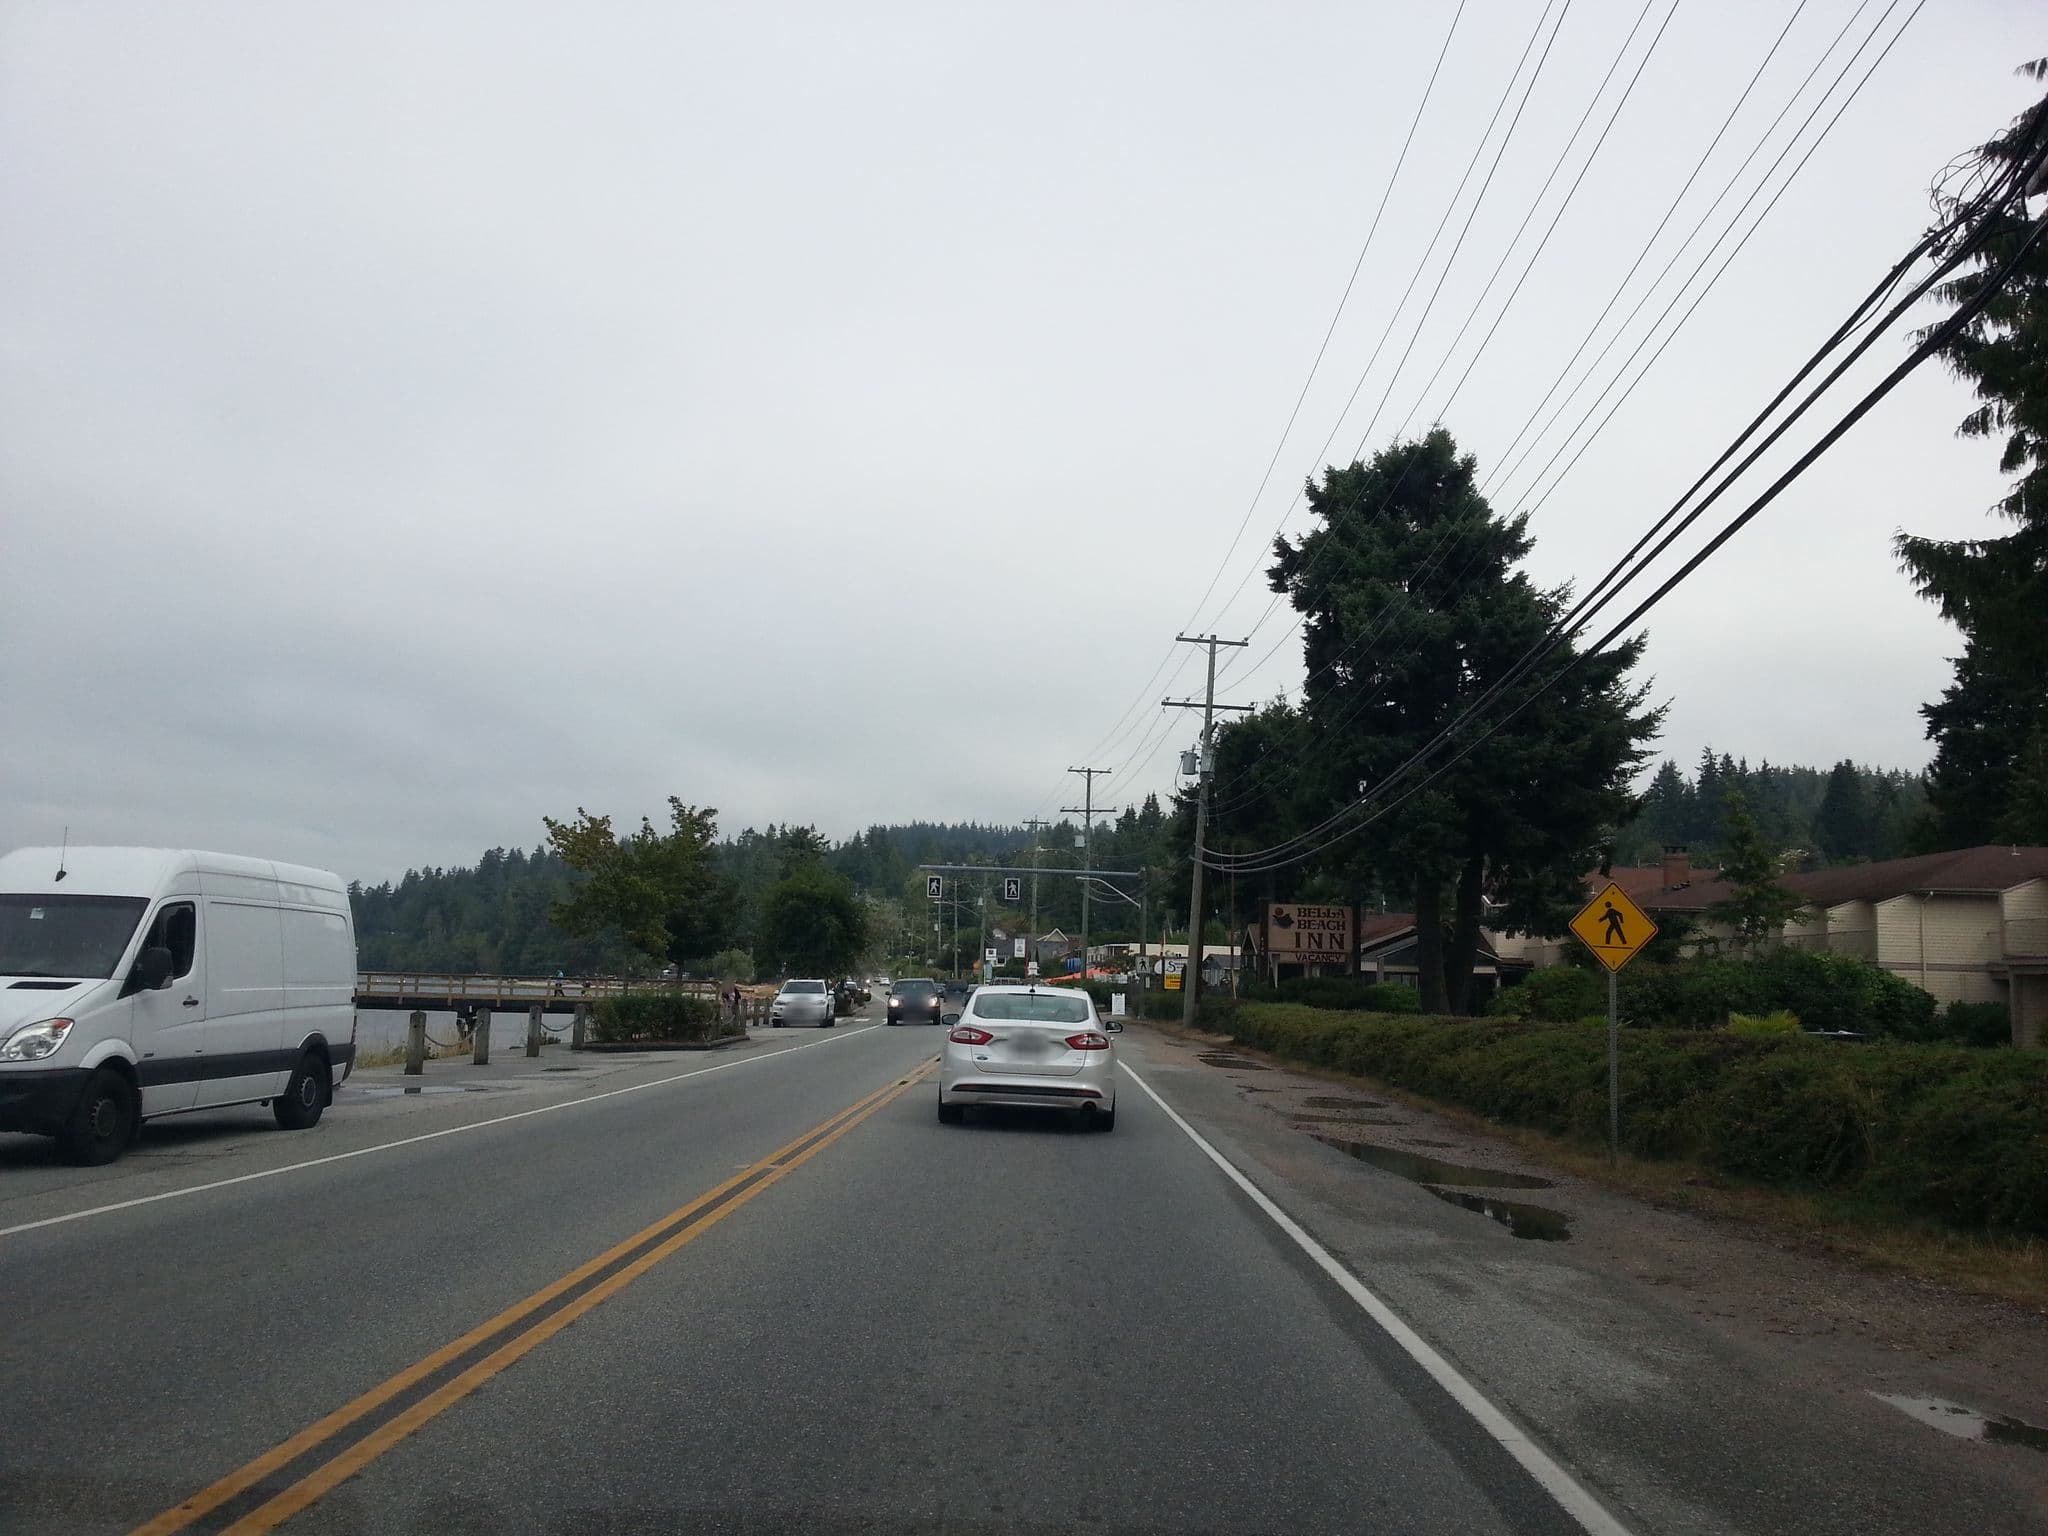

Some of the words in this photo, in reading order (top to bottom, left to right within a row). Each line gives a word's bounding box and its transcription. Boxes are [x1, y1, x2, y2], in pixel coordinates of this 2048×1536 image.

[1297, 908, 1345, 919] BELLA
[1297, 919, 1345, 930] BEACH
[1295, 932, 1344, 949] INN
[1296, 954, 1341, 962] VACANCY
